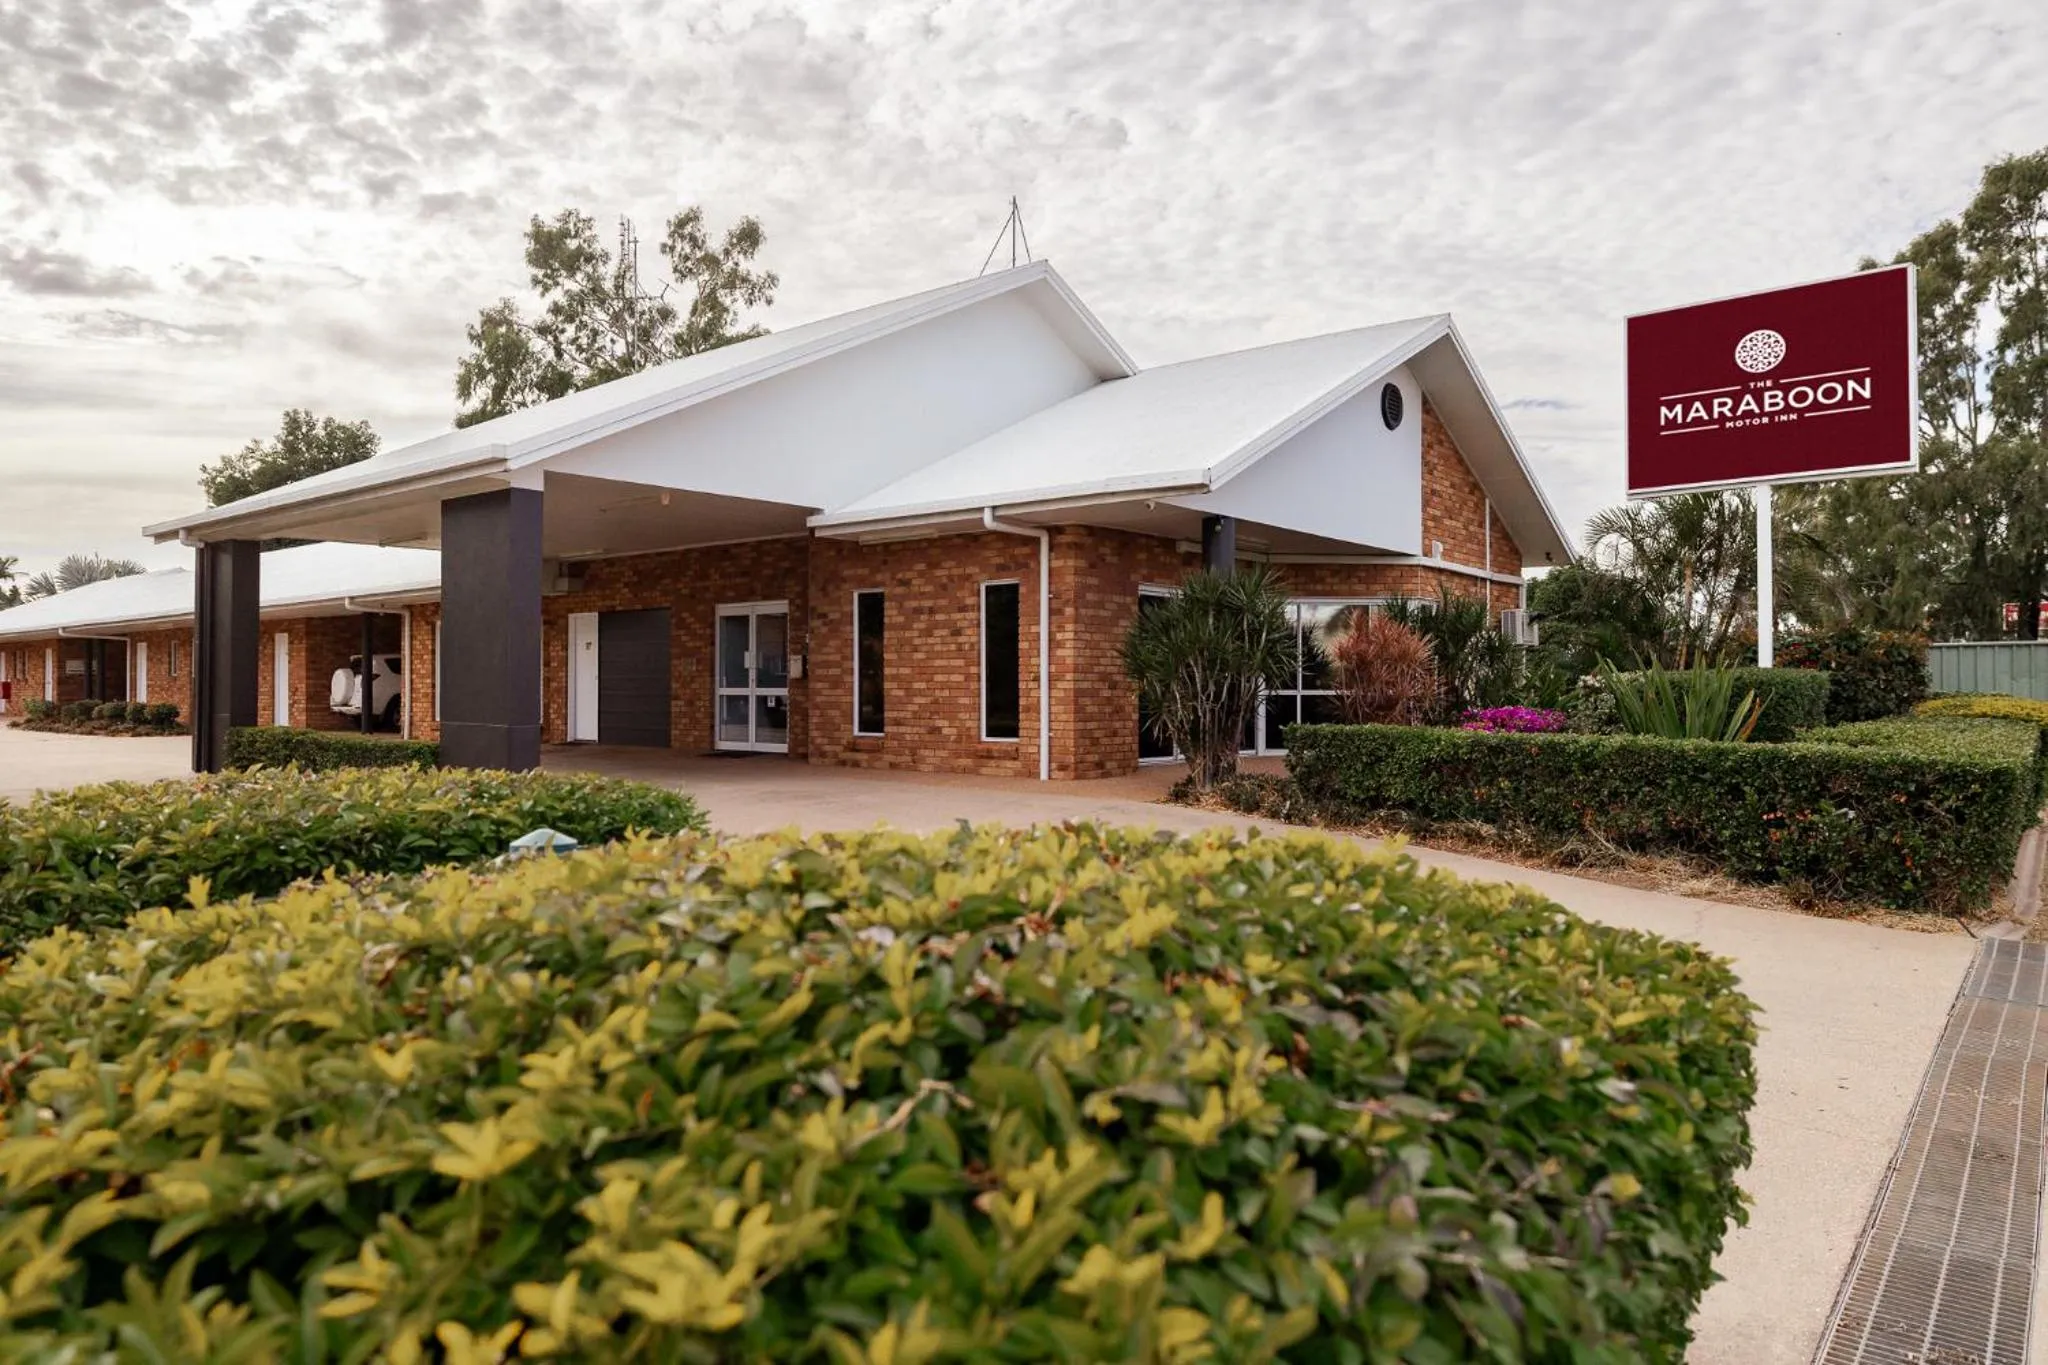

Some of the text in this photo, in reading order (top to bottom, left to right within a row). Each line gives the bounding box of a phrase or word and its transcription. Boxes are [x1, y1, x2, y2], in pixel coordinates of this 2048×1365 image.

[1749, 379, 1773, 389] THE
[1660, 377, 1871, 426] MARABOON
[1725, 413, 1798, 428] MOTOR INN
